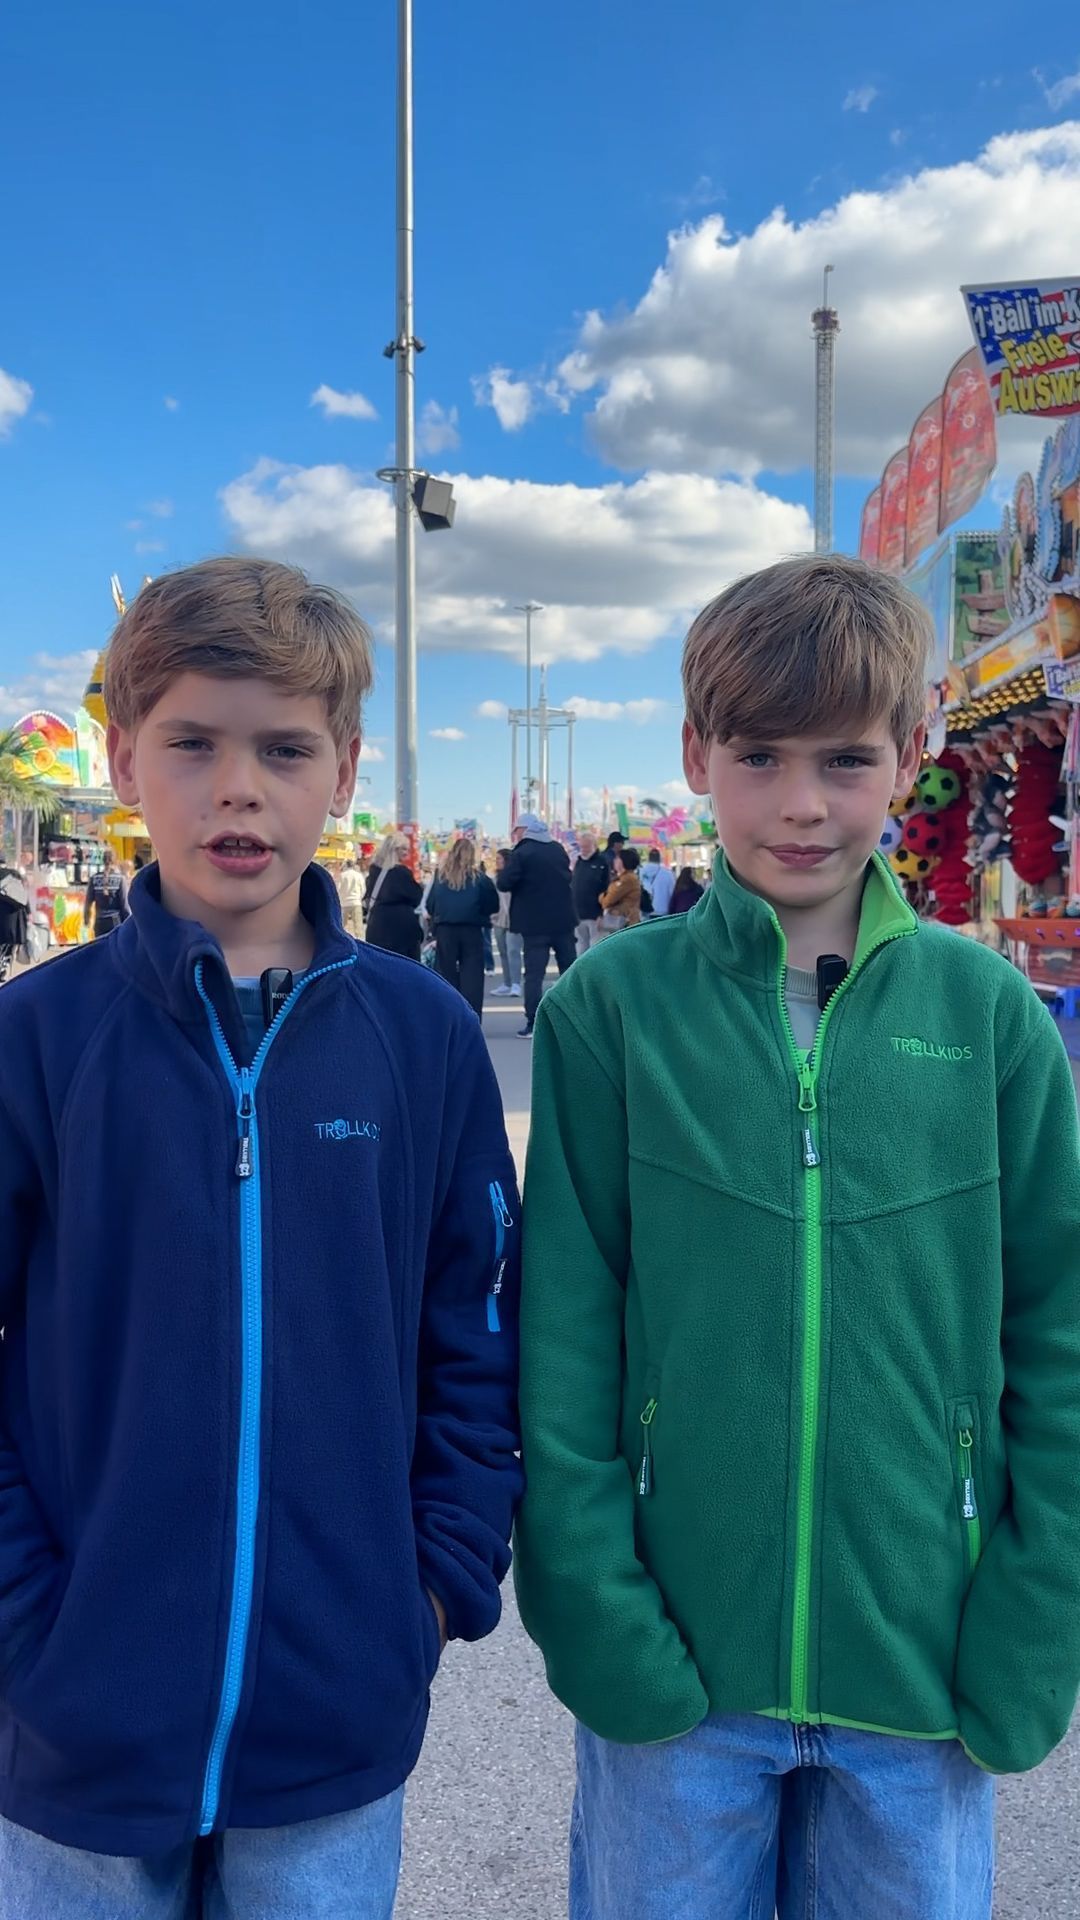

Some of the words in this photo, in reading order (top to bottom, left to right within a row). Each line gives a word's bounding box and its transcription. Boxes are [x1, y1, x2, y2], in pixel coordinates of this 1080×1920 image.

[974, 303, 988, 339] 1
[990, 296, 1032, 336] Ball
[1034, 294, 1063, 328] im
[1001, 330, 1068, 375] Freie
[891, 1037, 973, 1060] TROLLKIDS
